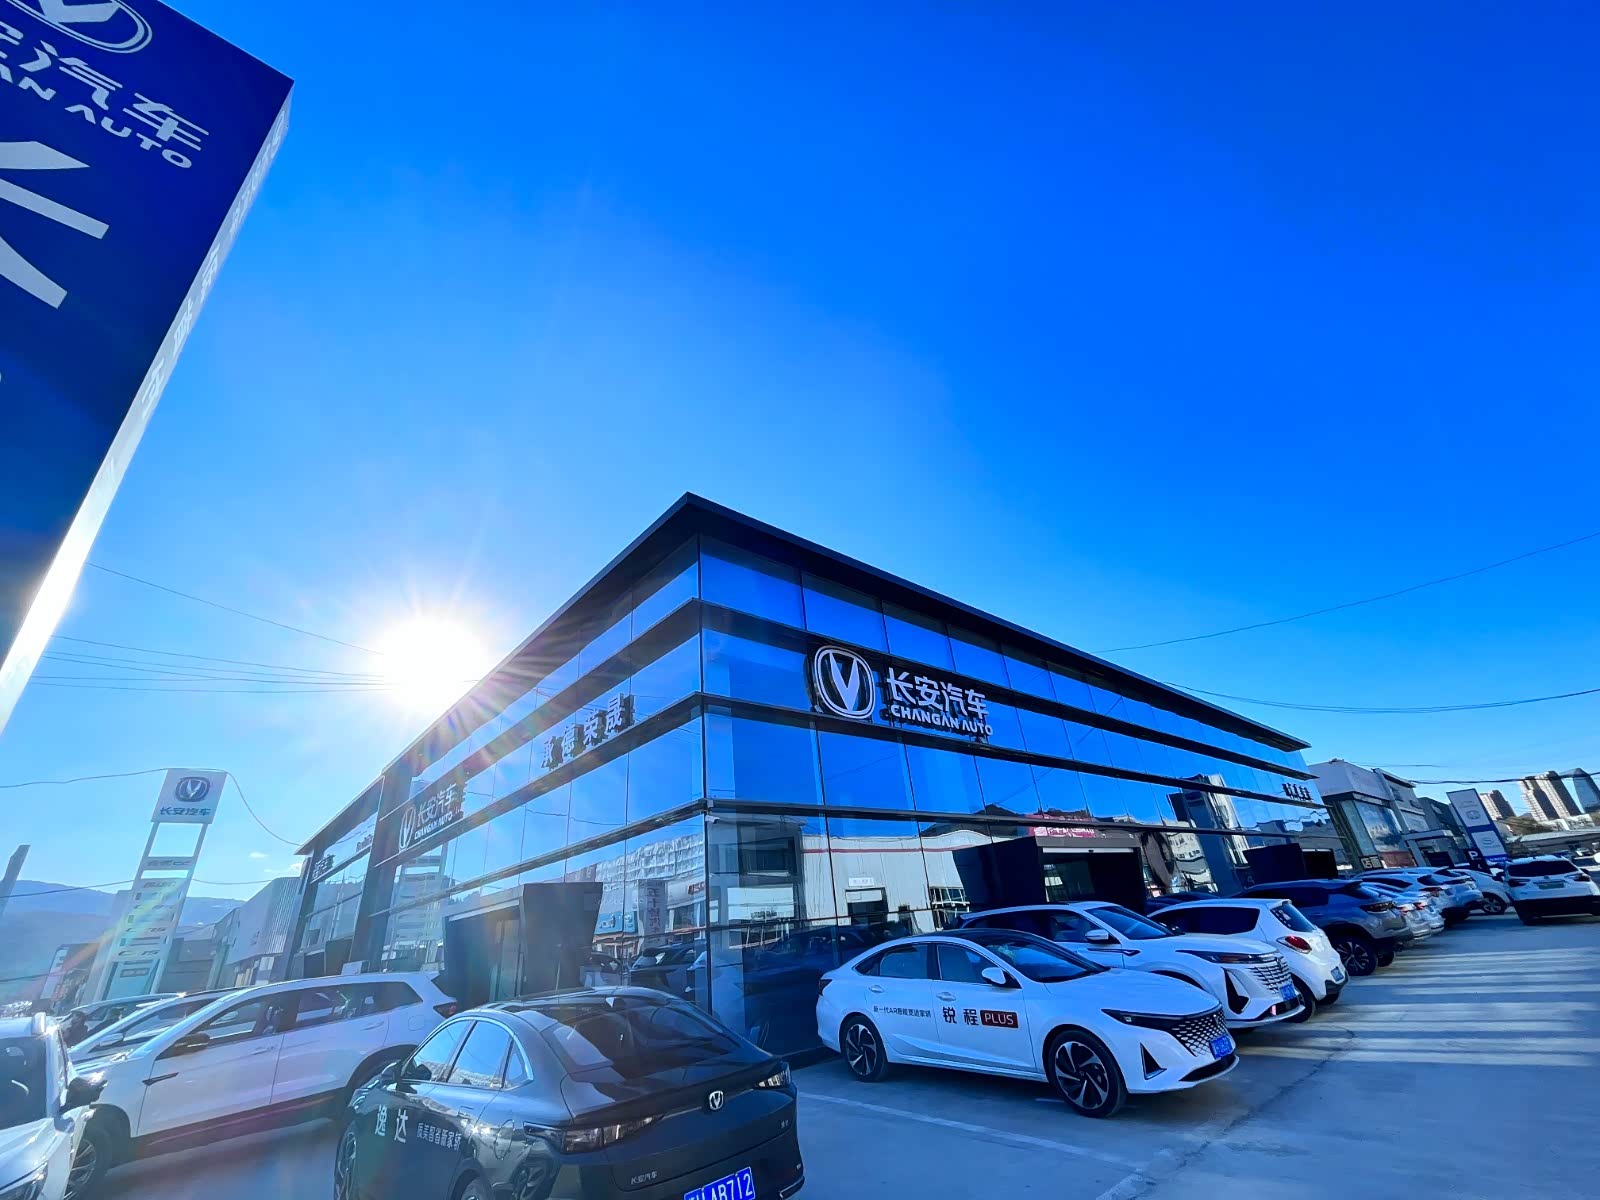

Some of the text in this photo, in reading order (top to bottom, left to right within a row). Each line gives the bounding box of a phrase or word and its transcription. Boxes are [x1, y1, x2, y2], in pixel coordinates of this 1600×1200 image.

[64, 104, 192, 169] AUTO
[886, 667, 990, 720] 长安汽车
[890, 704, 993, 736] CHANGAN AUTO
[160, 806, 212, 817] 长安汽车
[416, 782, 457, 828] 长安汽车
[942, 1006, 1014, 1026] 锐程 PLUS
[375, 1104, 409, 1144] 逸达
[687, 1173, 753, 1200] AB712
